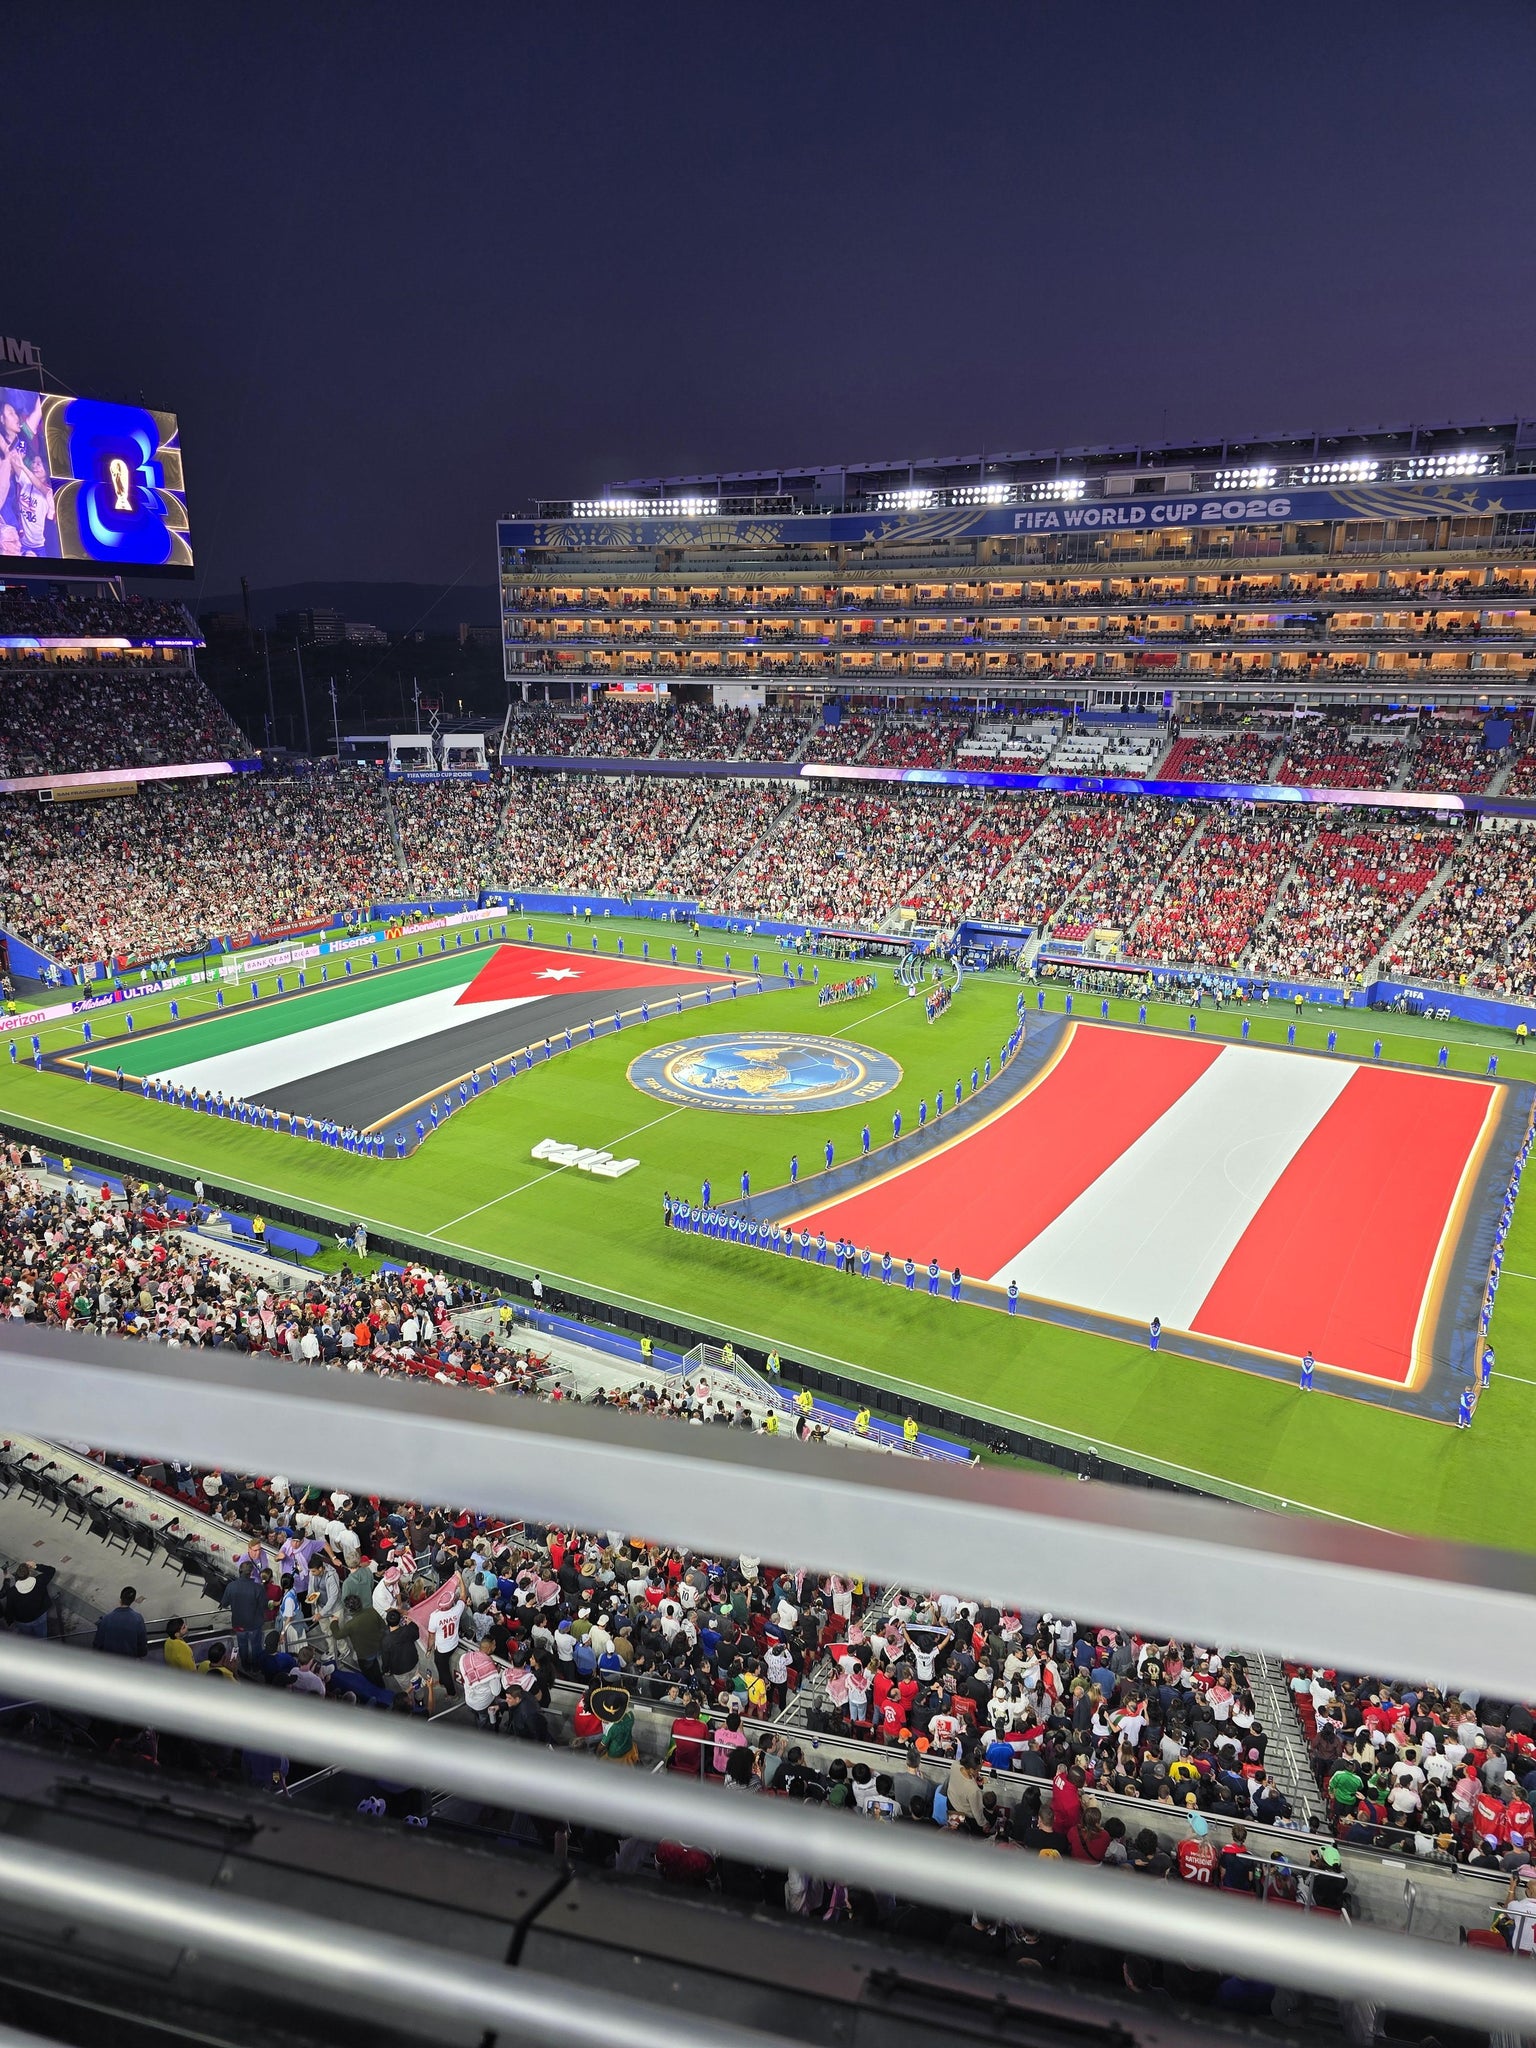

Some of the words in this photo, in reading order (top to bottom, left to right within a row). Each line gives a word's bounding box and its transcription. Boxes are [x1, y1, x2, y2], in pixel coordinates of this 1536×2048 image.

[1014, 511, 1060, 529] FIFA
[1063, 506, 1148, 528] WORLD
[1151, 504, 1197, 522] CUP
[1201, 498, 1292, 520] 2026
[71, 788, 106, 796] FRANCISCO
[272, 924, 291, 933] JORDAN
[309, 917, 325, 926] WORLD
[402, 919, 446, 936] McDonald's
[329, 934, 376, 953] Hisense
[246, 960, 267, 969] BANK
[278, 949, 310, 962] AMRICA
[73, 994, 113, 1014] Michelob
[123, 982, 162, 999] ULTRA
[1404, 990, 1425, 1000] FIFA
[0, 1012, 45, 1031] verizon
[651, 1044, 687, 1060] FIFA
[852, 1080, 888, 1097] FIFA
[660, 1088, 701, 1103] WORLD
[702, 1100, 734, 1109] CUP
[682, 1590, 690, 1602] 10
[439, 1615, 458, 1626] ANAS
[442, 1622, 456, 1640] 10
[1199, 1681, 1209, 1690] 21
